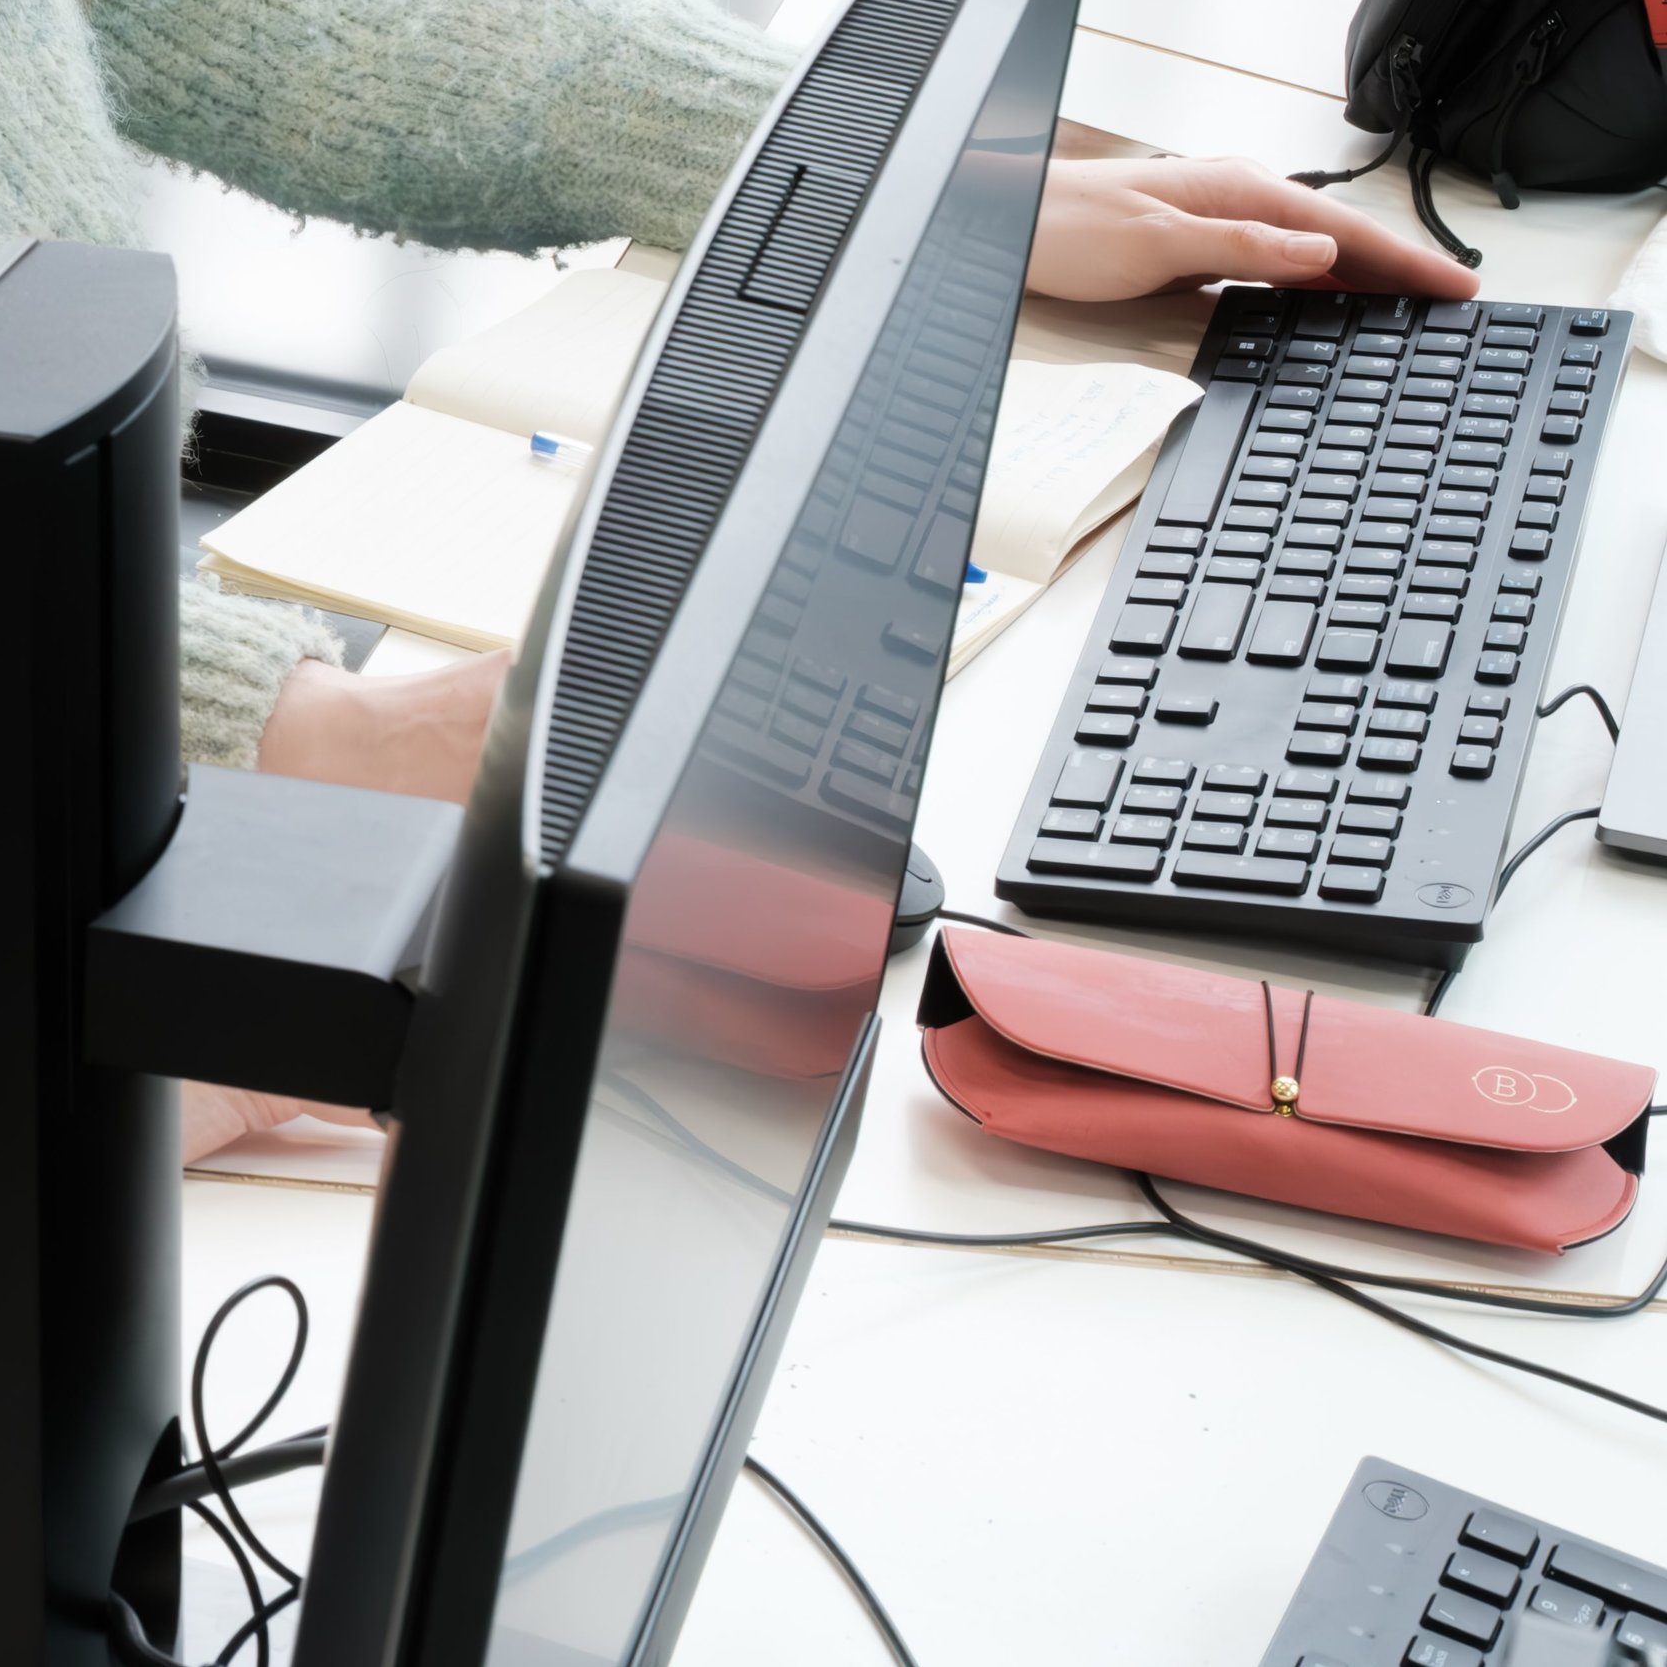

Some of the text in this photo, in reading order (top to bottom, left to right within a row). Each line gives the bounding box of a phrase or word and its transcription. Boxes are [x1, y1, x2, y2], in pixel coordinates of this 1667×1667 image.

[1438, 359, 1454, 368] W
[1350, 429, 1365, 437] G
[1342, 453, 1359, 461] H
[1272, 460, 1288, 468] N
[1386, 526, 1403, 534] O
[1493, 1074, 1516, 1097] B
[1541, 1600, 1558, 1612] 9
